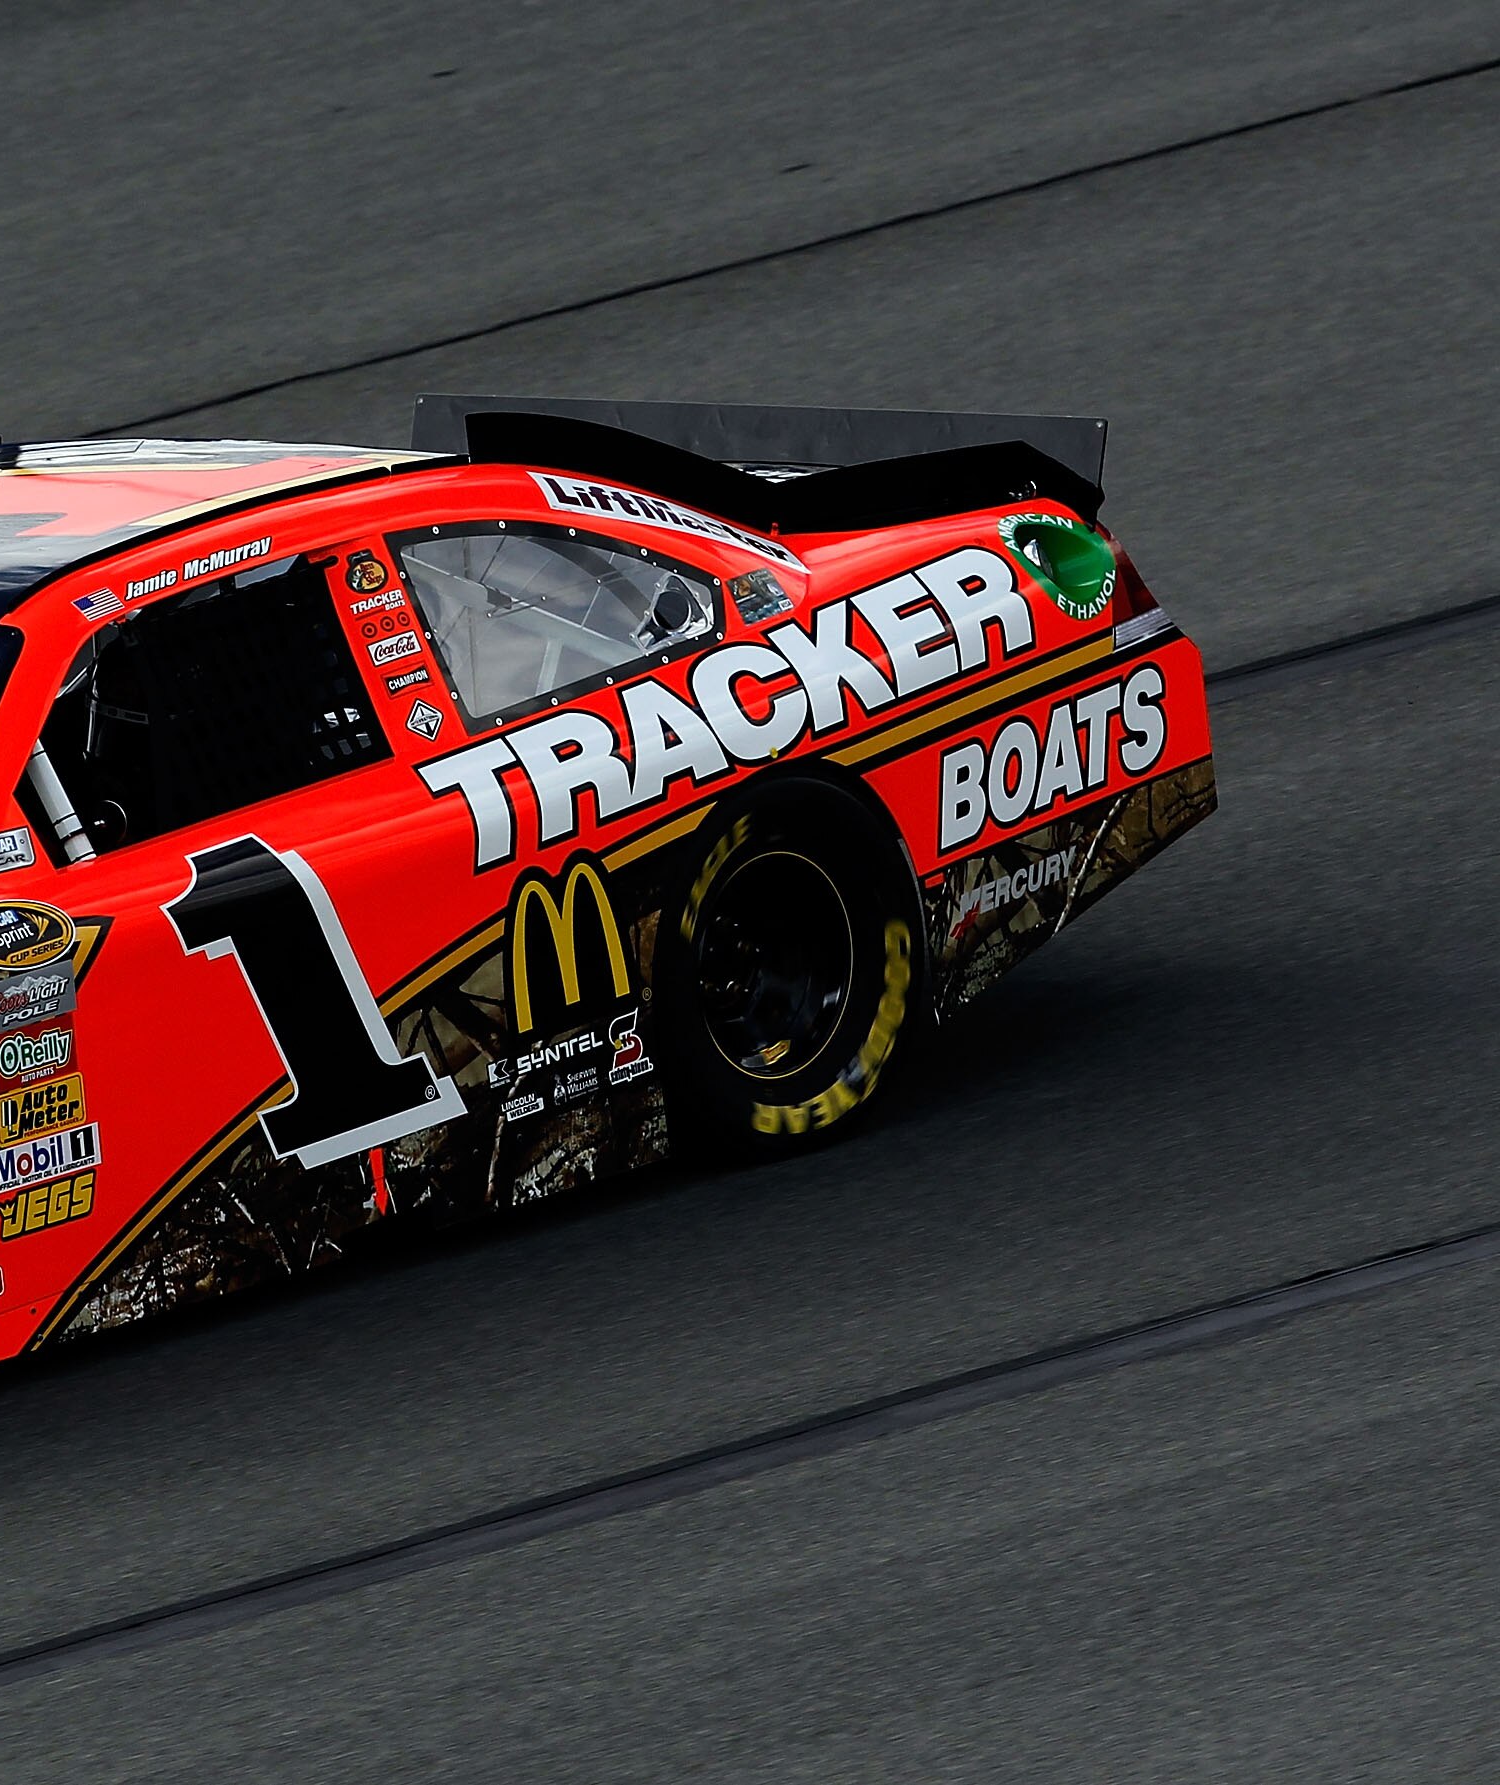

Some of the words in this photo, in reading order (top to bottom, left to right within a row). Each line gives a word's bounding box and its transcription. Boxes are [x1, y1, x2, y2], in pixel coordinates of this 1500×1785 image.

[542, 477, 789, 562] LiftMaster
[998, 513, 1074, 552] AMERICAN
[125, 569, 177, 601] Jamie
[183, 536, 272, 581] McMurray
[350, 589, 403, 615] TRACKER
[385, 600, 405, 611] BOATS
[1057, 569, 1116, 619] ETHANOL
[388, 669, 428, 690] CHAMPION
[419, 549, 1033, 867] TRACKER
[941, 668, 1165, 850] BOATS
[959, 846, 1077, 917] MERCURY
[10, 950, 29, 964] CUP
[31, 939, 64, 957] SERIES
[28, 979, 68, 1003] LIGHT
[159, 833, 468, 1170] 1
[3, 1000, 58, 1026] POLE
[0, 1031, 70, 1075] O'Reilly
[517, 1032, 603, 1075] SYNTEL
[21, 1070, 36, 1083] AUTO
[36, 1067, 54, 1078] PARTS
[21, 1084, 68, 1112] Auto
[501, 1093, 535, 1112] LINCOLN
[19, 1100, 80, 1134] Meter
[22, 1172, 43, 1184] MOTOR
[2, 1172, 94, 1238] JEGS
